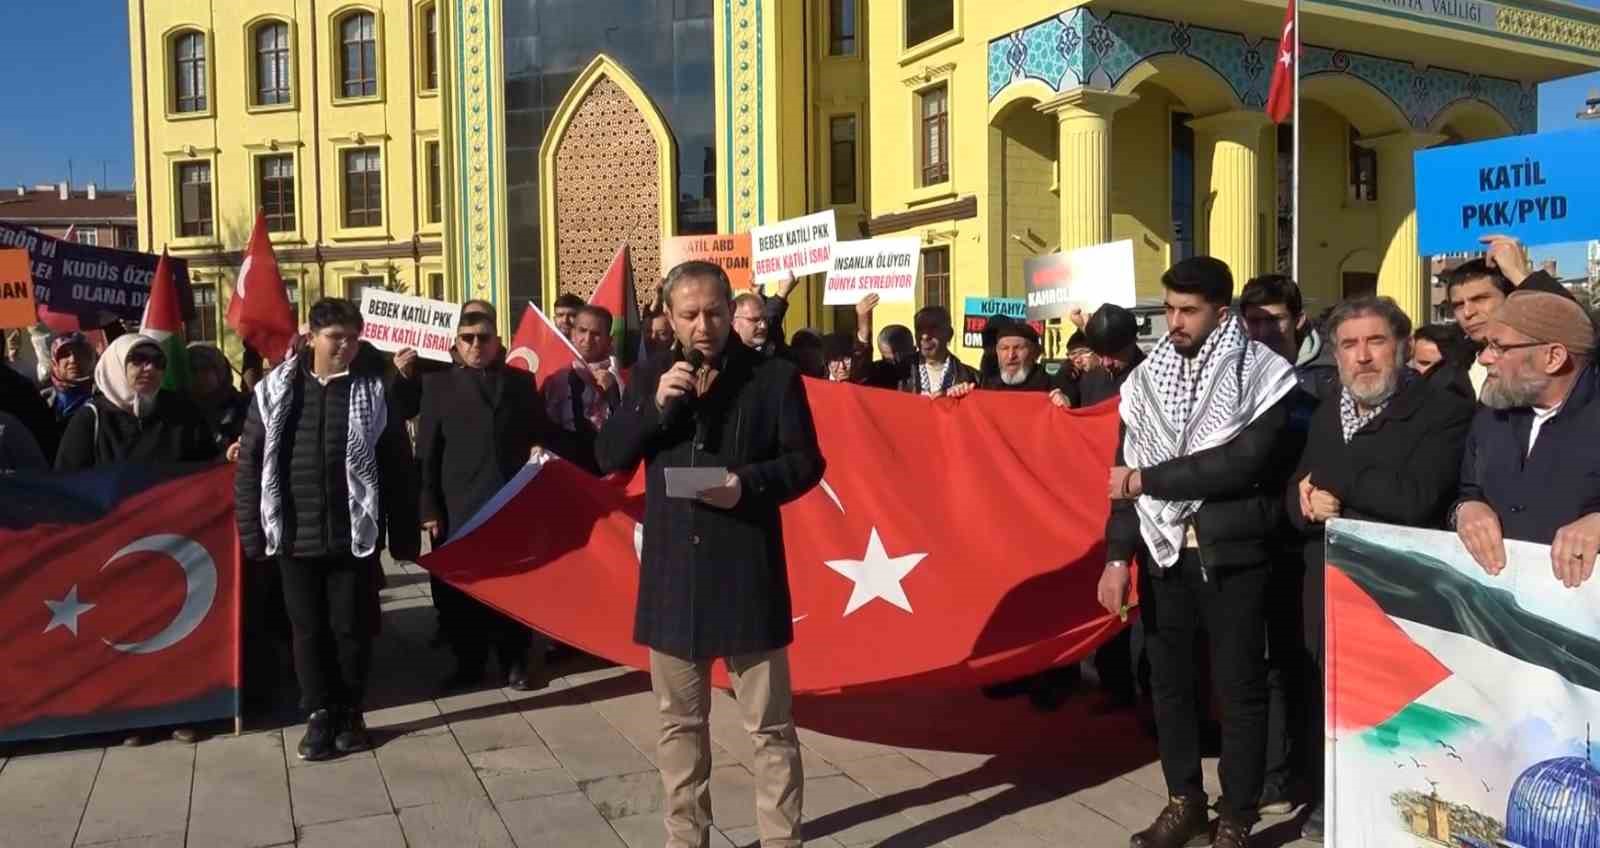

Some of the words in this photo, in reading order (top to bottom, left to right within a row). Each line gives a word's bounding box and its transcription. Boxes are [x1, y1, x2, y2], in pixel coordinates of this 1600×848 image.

[1479, 157, 1546, 192] KATİL
[1462, 196, 1568, 229] PKK/PYD
[686, 239, 710, 253] ATİL
[759, 232, 785, 252] BEBEK
[786, 225, 811, 246] KATİLİ
[812, 224, 829, 240] PKK
[62, 258, 119, 282] KUDÜS
[756, 256, 781, 275] BEBEK
[834, 255, 875, 271] İNSANLIK
[876, 251, 911, 268] ÖLÜYOR
[0, 281, 29, 299] AN
[828, 273, 856, 290] DÜNYA
[858, 272, 912, 289] SEYREDİYOR
[72, 284, 126, 307] OLANA
[368, 299, 401, 319] BEBEK
[402, 303, 432, 325] KATİLİ
[433, 310, 453, 328] PKK
[361, 322, 391, 343] EBEK
[391, 326, 422, 348] KATİLİ
[965, 332, 983, 347] OM
